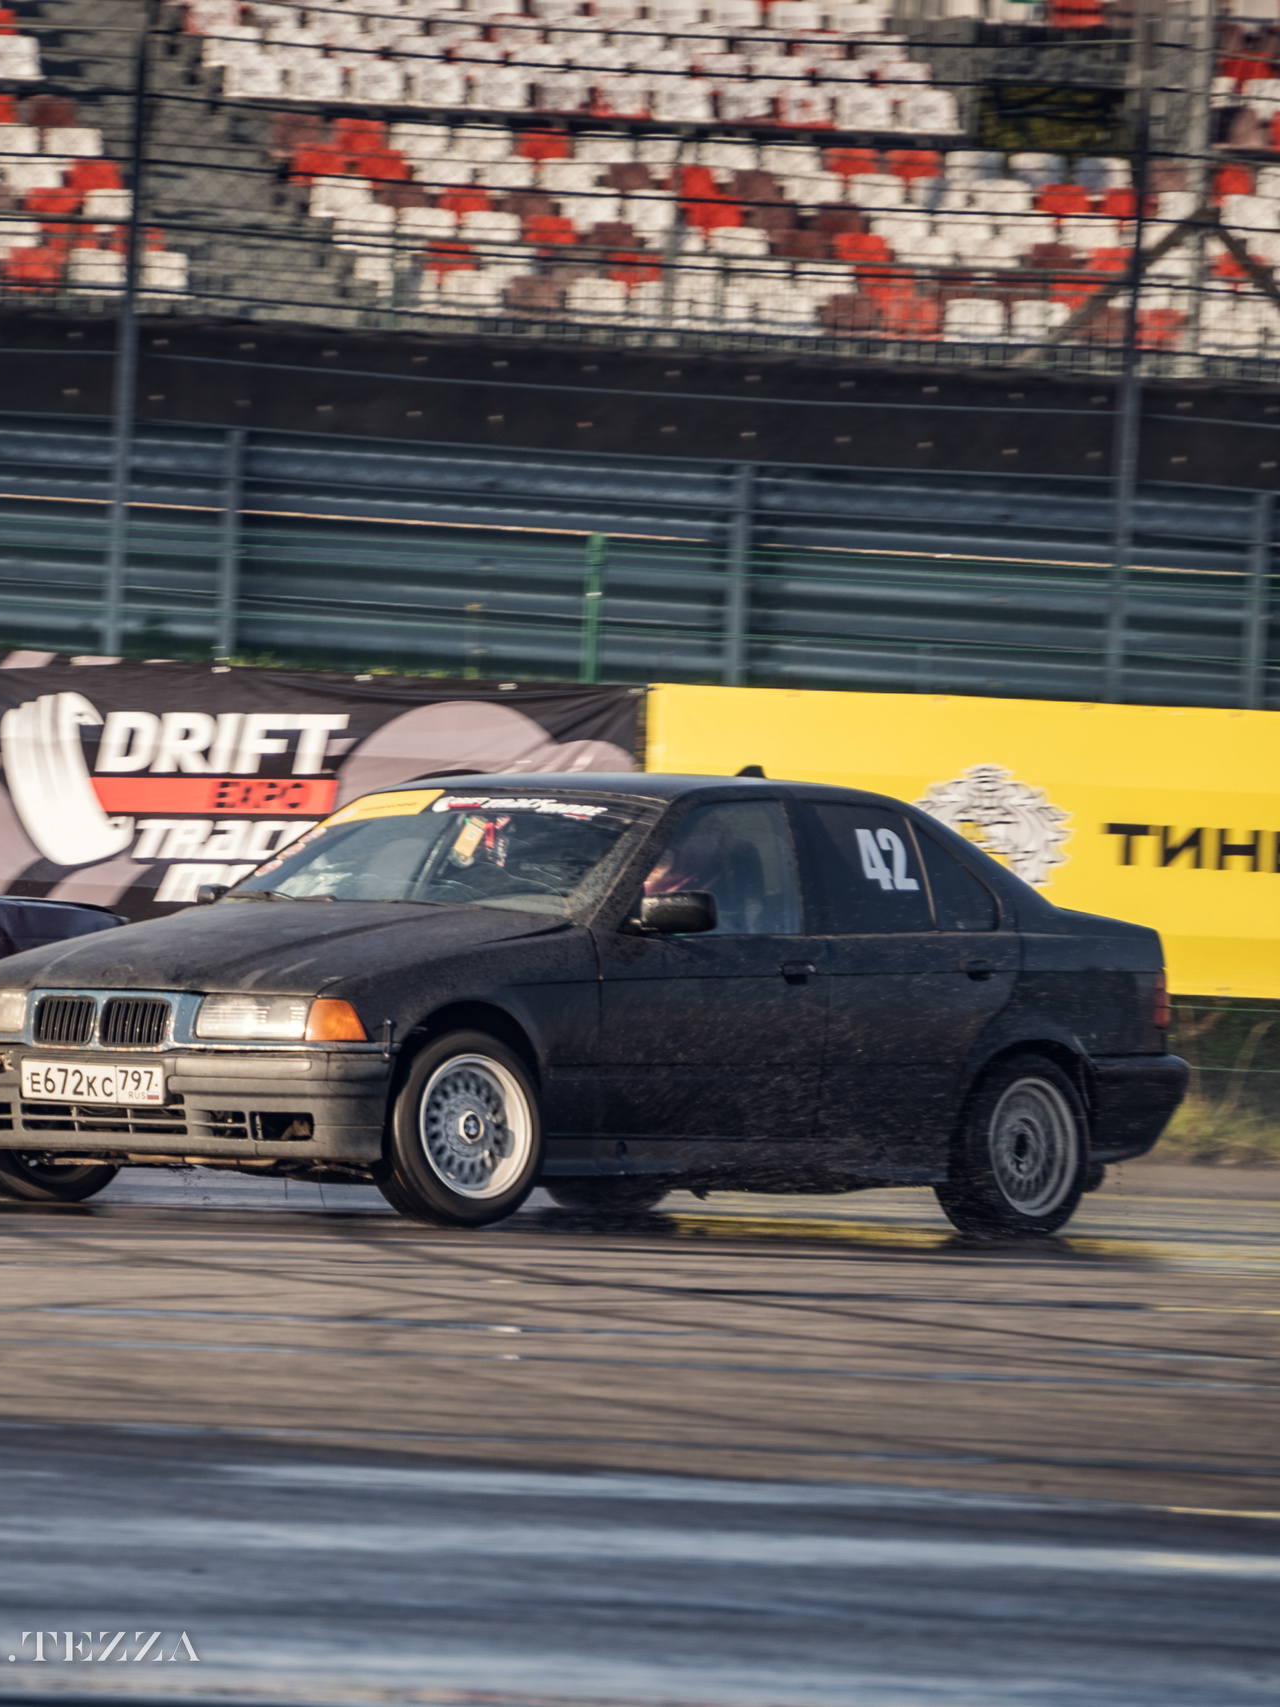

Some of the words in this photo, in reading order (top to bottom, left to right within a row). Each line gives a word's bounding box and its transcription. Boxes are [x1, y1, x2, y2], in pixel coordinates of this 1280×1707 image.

[95, 711, 349, 774] DRIFT
[208, 779, 316, 811] EXPO
[854, 828, 919, 891] 42
[1098, 823, 1280, 873] ТИН
[118, 1069, 154, 1091] 797
[128, 1091, 147, 1100] RUS
